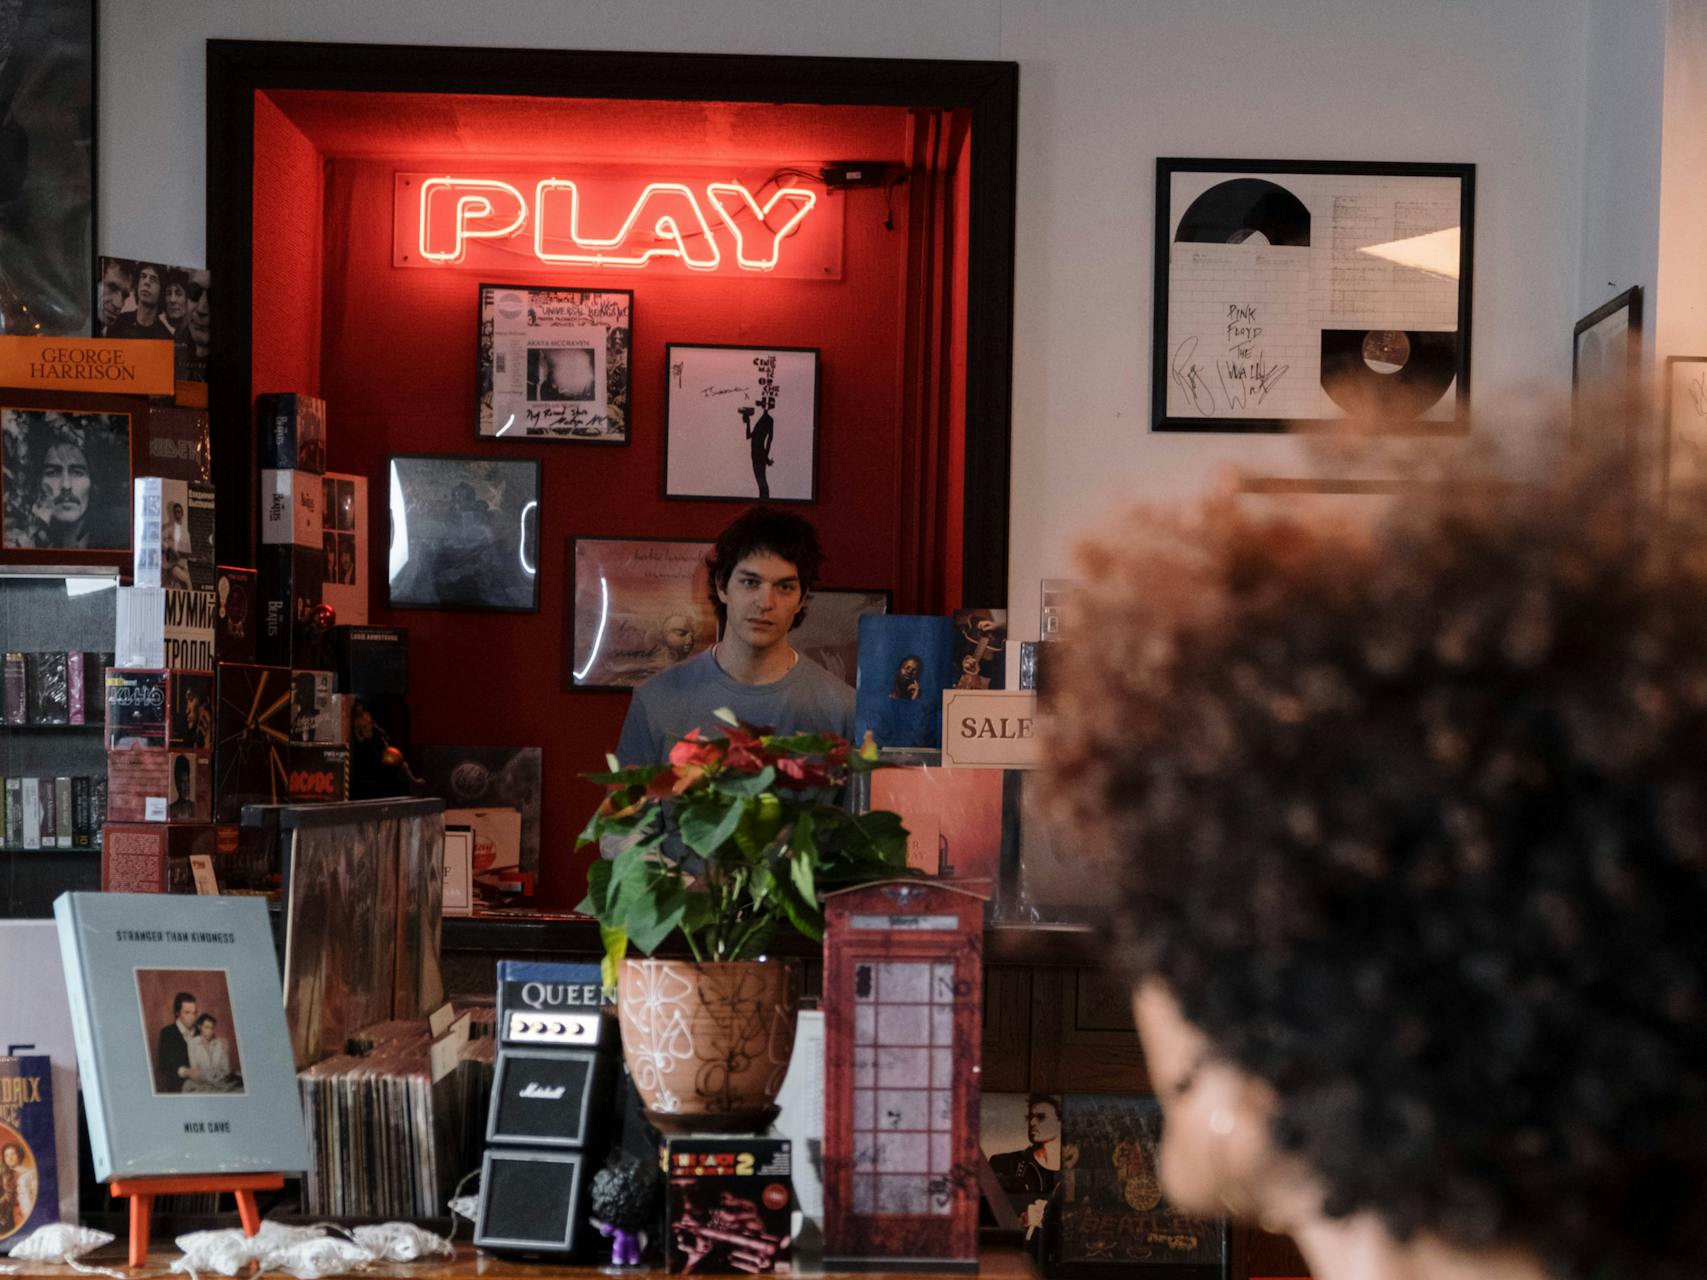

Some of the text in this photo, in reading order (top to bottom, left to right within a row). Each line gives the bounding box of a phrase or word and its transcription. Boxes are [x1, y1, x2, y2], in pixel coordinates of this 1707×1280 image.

[420, 177, 817, 270] PLAY
[1227, 304, 1256, 324] PINK
[1227, 320, 1263, 342] FLOYD
[41, 348, 125, 365] GEORGE
[29, 362, 136, 381] HARRISON
[165, 590, 216, 629] МУМИЙ
[264, 601, 284, 637] BEATLES
[961, 717, 1034, 739] SALE
[290, 771, 334, 794] AC/DC
[115, 930, 235, 944] STRANGER THAN KINDNESS
[521, 982, 618, 1009] QUEEN
[183, 1121, 231, 1134] NICK CAVE
[735, 1151, 756, 1177] 2
